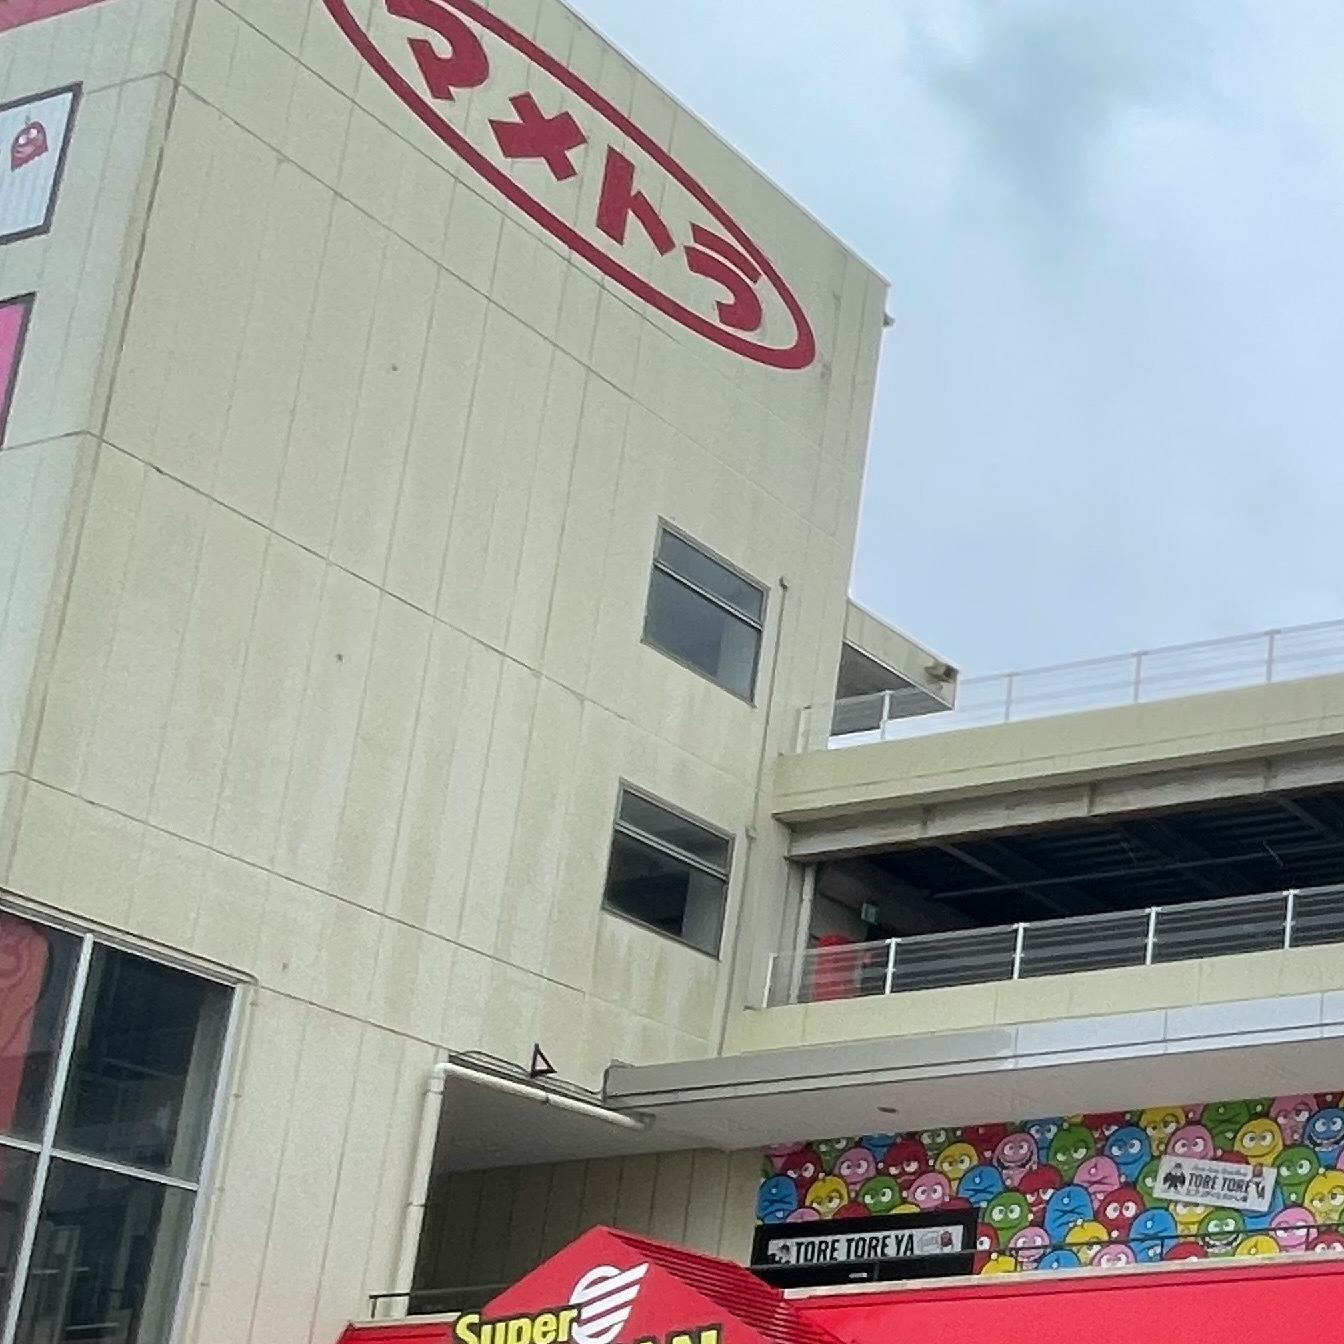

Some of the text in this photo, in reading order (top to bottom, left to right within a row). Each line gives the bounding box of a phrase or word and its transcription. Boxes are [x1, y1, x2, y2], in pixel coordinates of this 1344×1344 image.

[384, 0, 764, 334] マメトラ
[794, 1239, 840, 1264] TORE
[845, 1236, 890, 1261] TORE
[894, 1233, 915, 1257] YA
